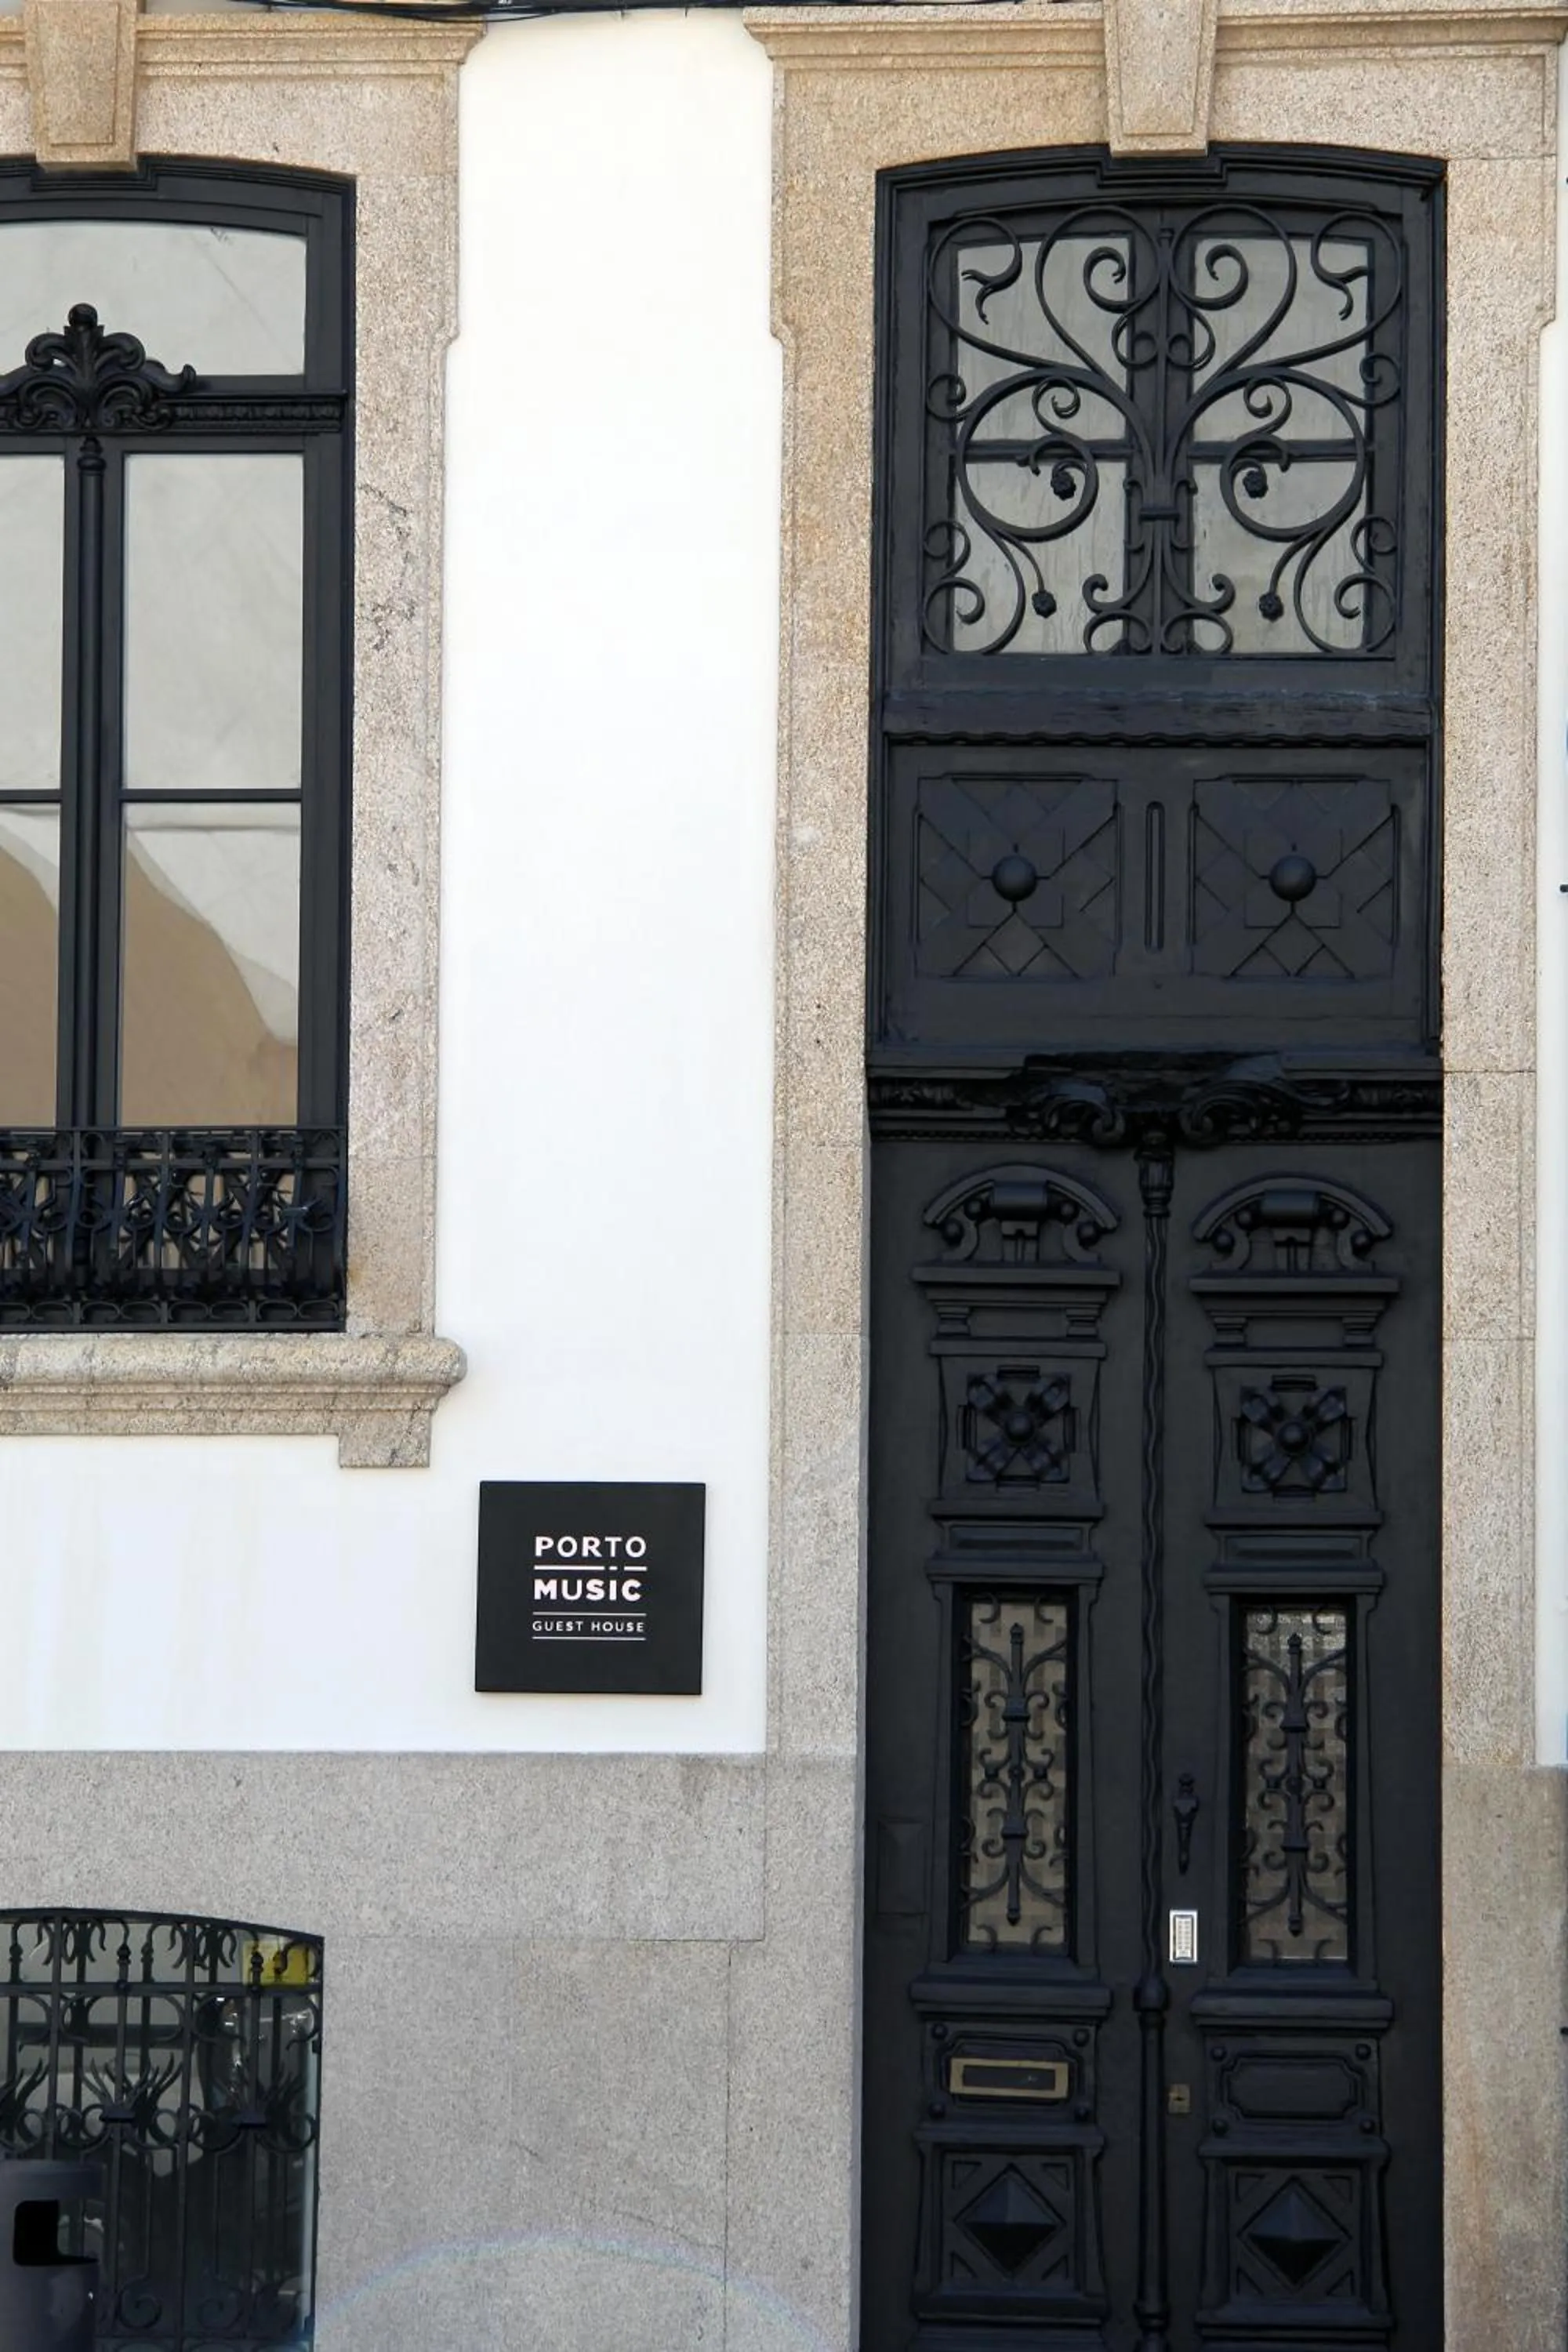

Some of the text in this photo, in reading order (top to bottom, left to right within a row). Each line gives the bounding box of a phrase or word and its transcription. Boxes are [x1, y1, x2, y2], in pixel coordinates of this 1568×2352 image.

[535, 1536, 647, 1558] PORTO
[533, 1578, 642, 1601] MUSIC
[532, 1621, 644, 1632] GUEST HOUSE
